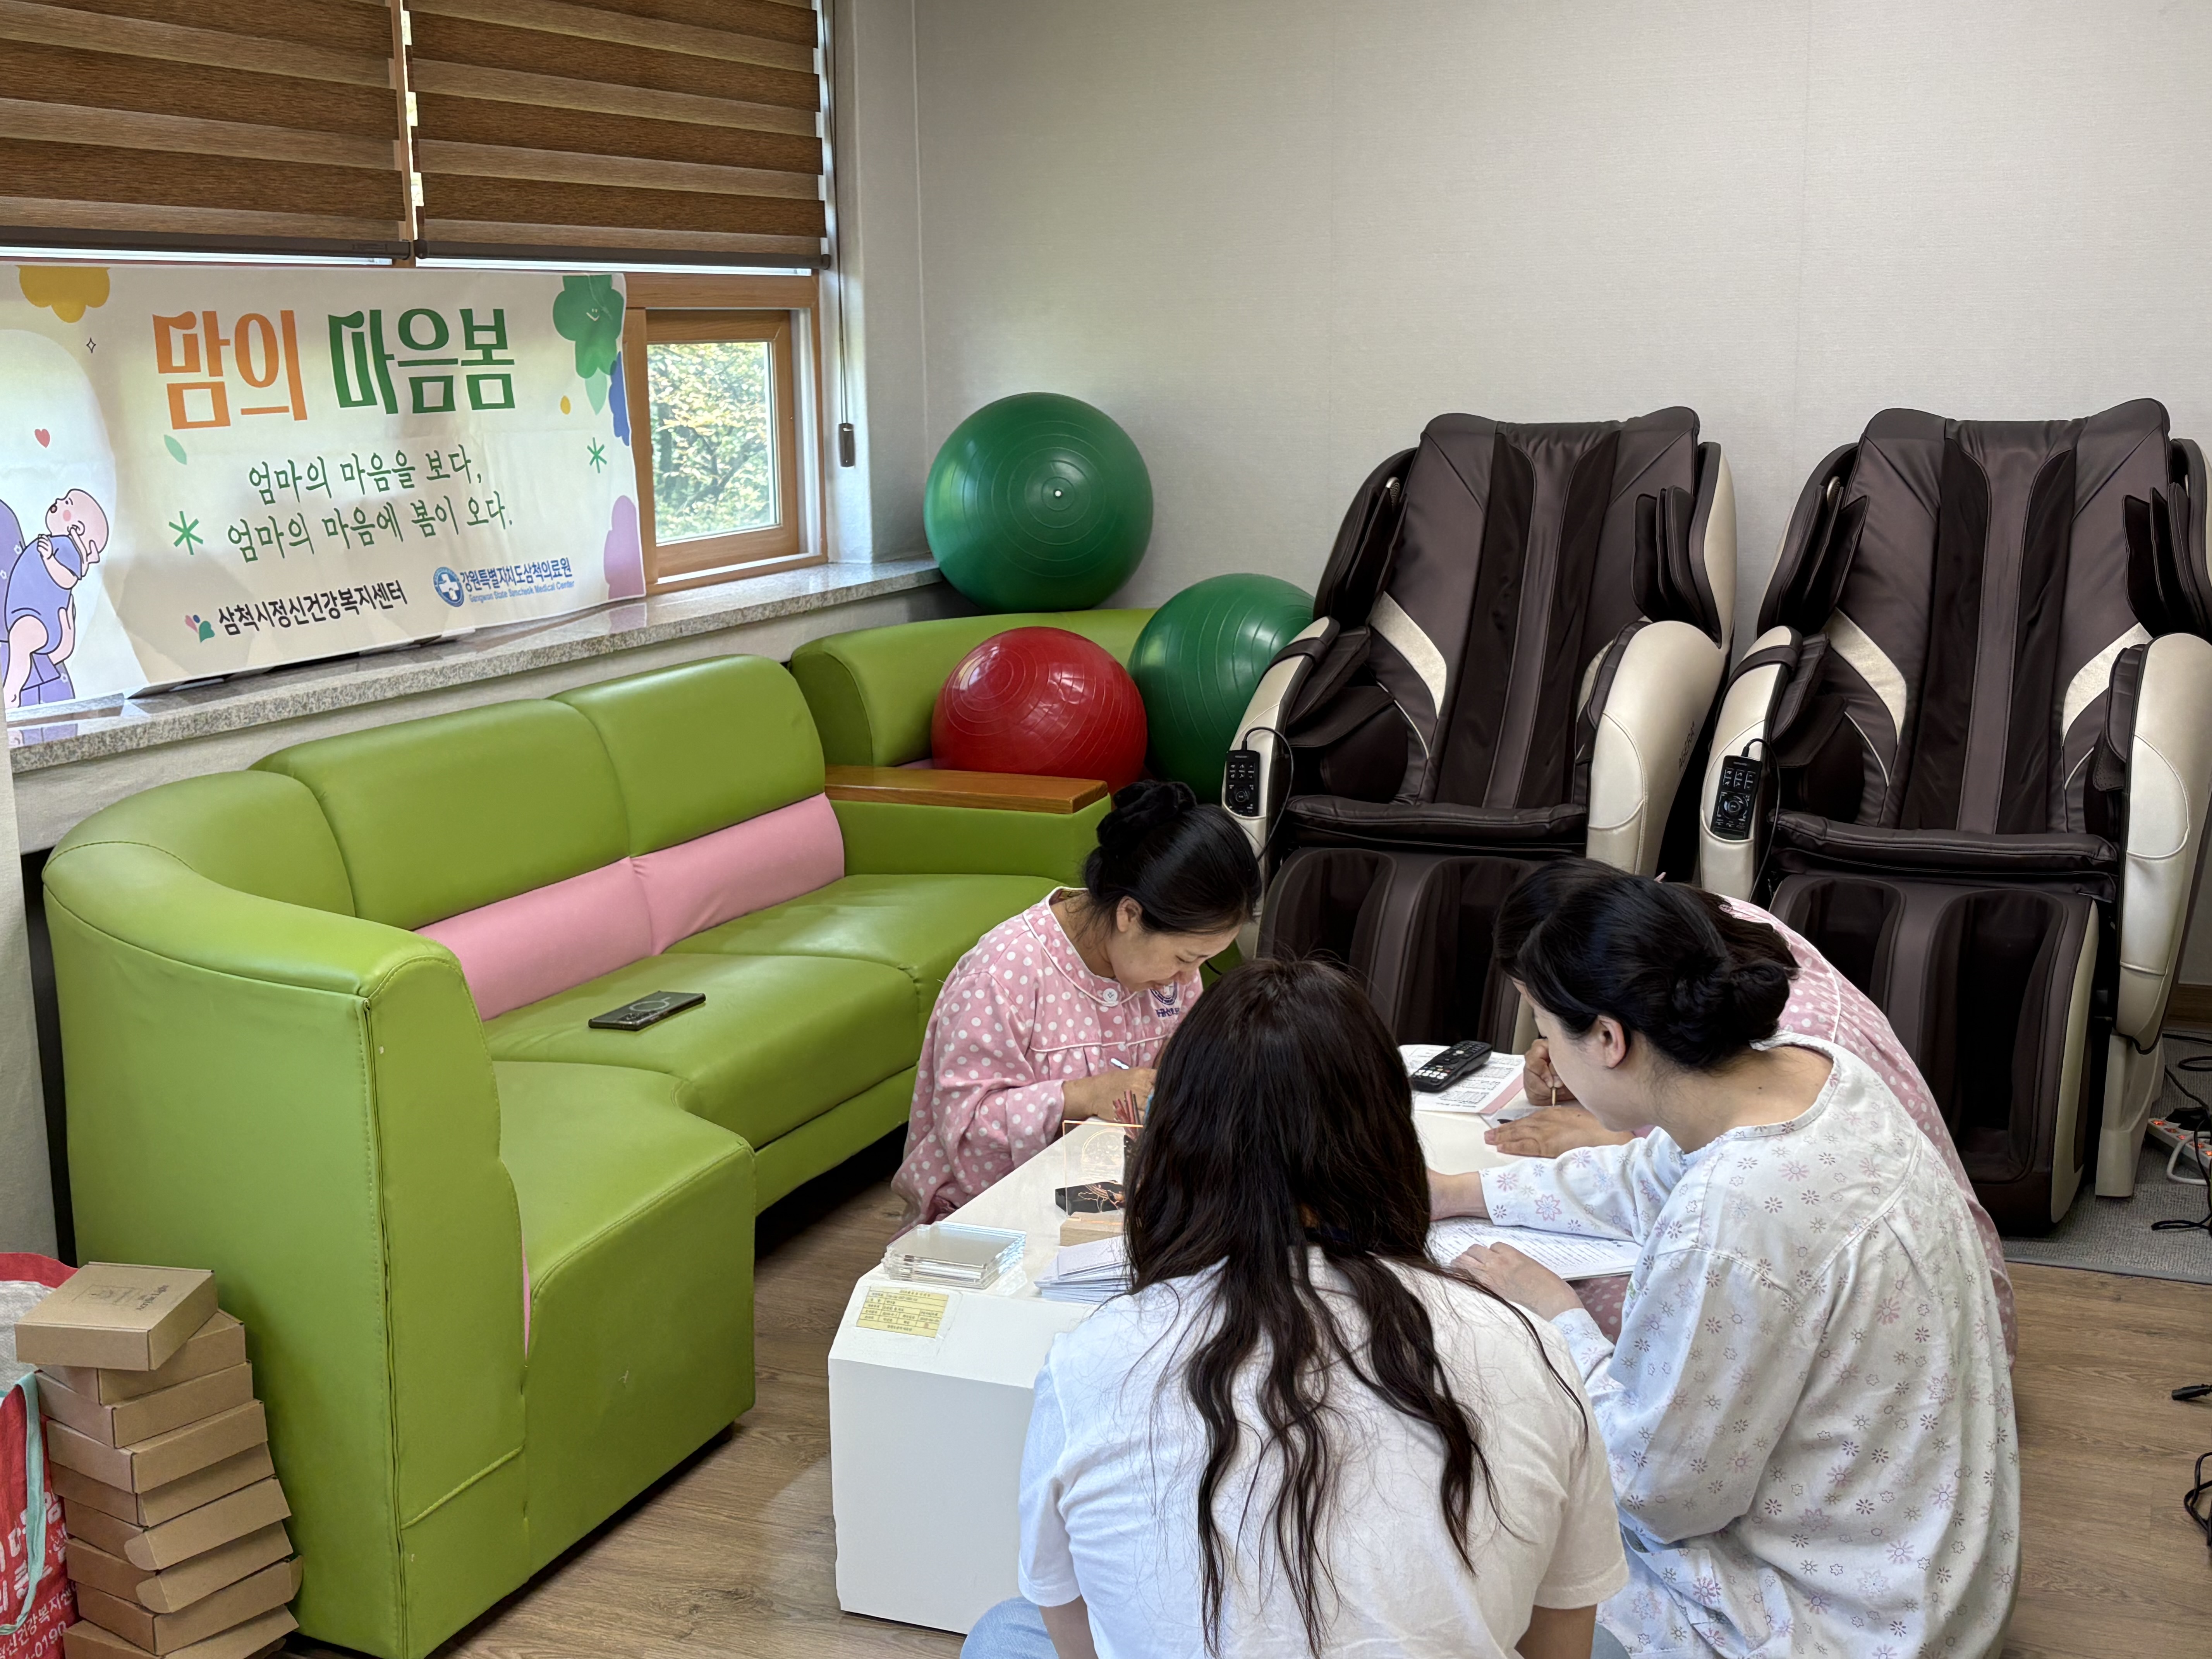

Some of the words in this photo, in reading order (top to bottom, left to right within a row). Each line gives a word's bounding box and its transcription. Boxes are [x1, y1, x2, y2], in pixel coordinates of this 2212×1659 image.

[152, 309, 307, 430] 맘의
[328, 308, 515, 414] 마음봄
[249, 456, 332, 505] 엄마의
[340, 450, 416, 495] 마음을
[426, 444, 483, 484] 보다,
[228, 512, 314, 563] 엄마의
[322, 501, 404, 549] 마음에
[410, 495, 459, 538] 봄이
[466, 491, 513, 530] 오다.
[460, 557, 572, 592] 강원특별자치도삼척의료원
[218, 580, 408, 635] 삼척시정신건강복지센터
